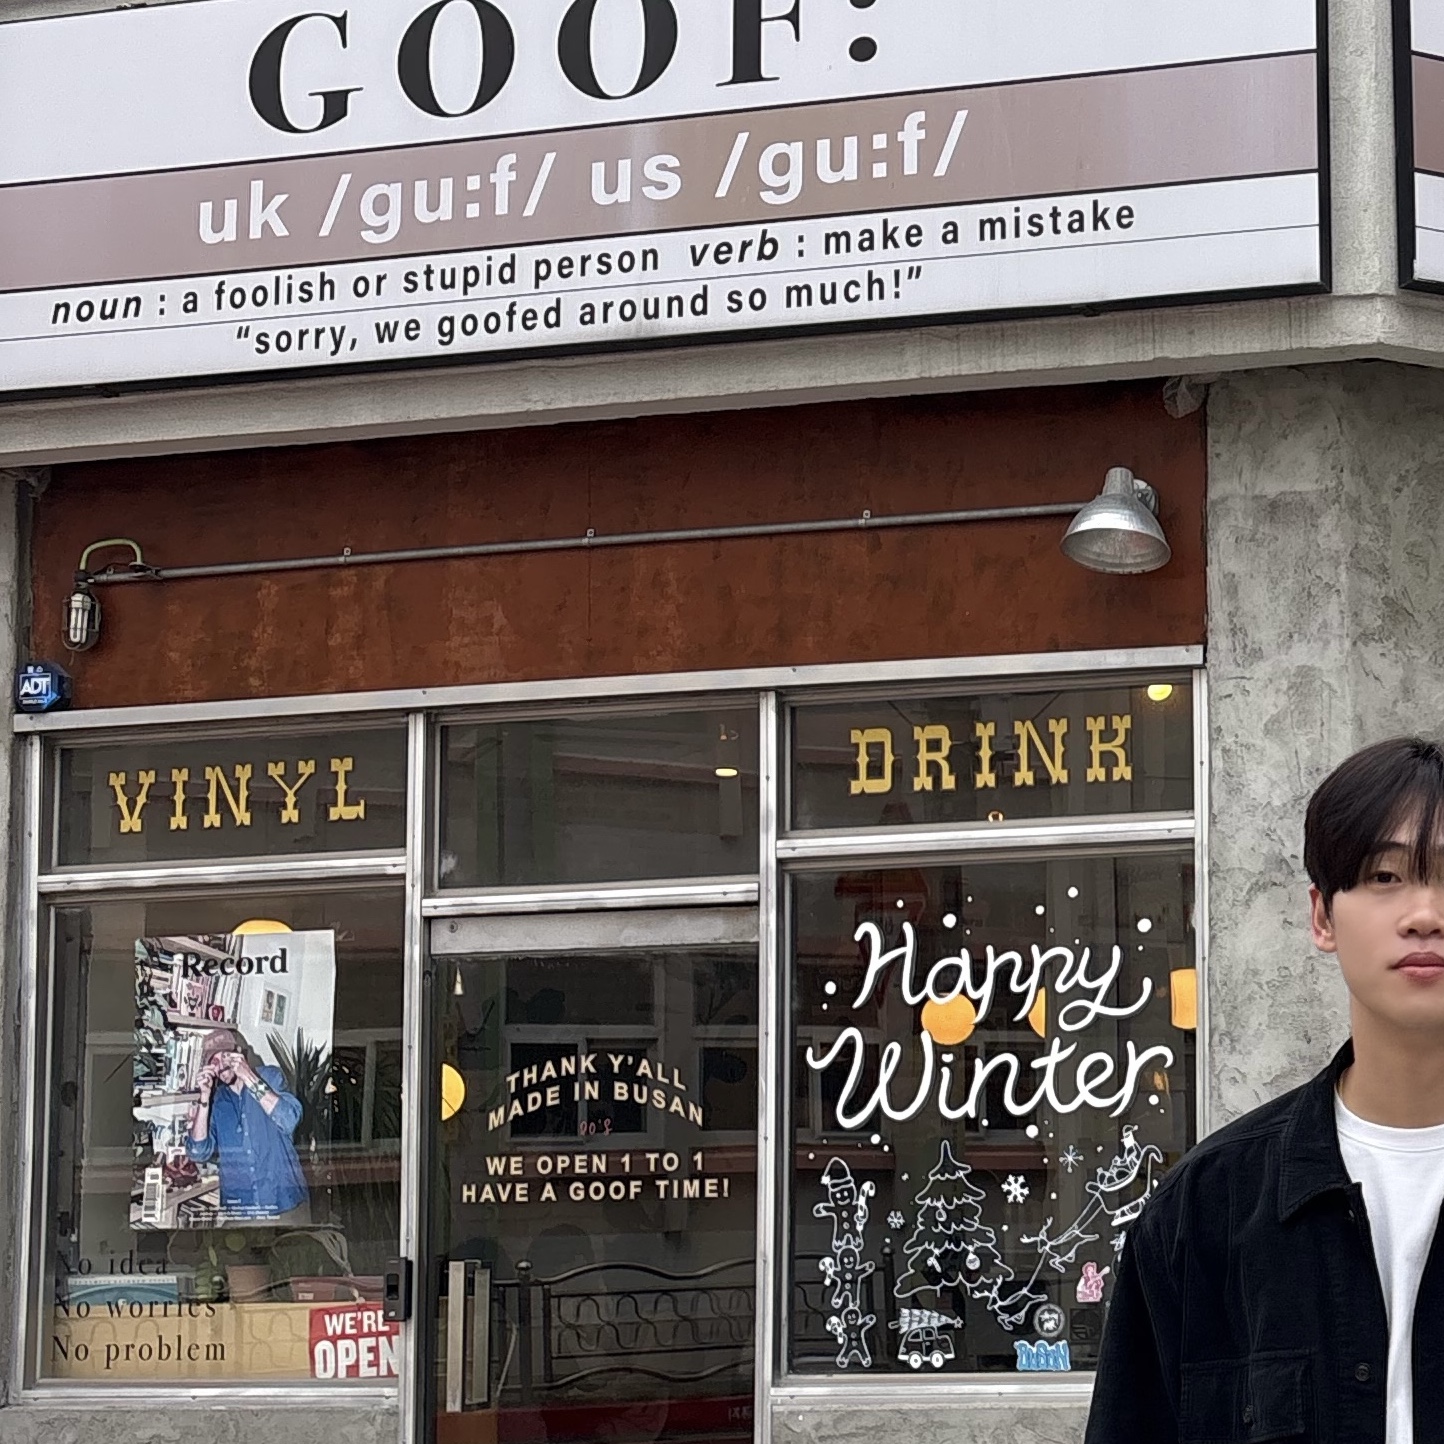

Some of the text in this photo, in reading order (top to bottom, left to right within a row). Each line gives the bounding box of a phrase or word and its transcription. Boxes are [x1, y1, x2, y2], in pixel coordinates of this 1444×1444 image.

[248, 0, 878, 134] GOOF:
[198, 109, 969, 244] uk /gu:f/ us /gu:f/
[51, 199, 1136, 325] noun : a foolish or stupid person verb : make a mistake
[236, 265, 922, 356] "sorry, we goofed around so much!"
[20, 677, 51, 696] ADT
[849, 713, 1133, 796] DRINK
[108, 755, 366, 834] VINYL
[181, 948, 289, 979] Record
[853, 921, 1153, 1032] Happy
[506, 1052, 686, 1094] THANK Y'ALL
[806, 1026, 1174, 1129] Winter
[488, 1080, 703, 1131] MADE IN BUSAN
[485, 1151, 703, 1177] WE OPEN 1 TO 1
[462, 1178, 731, 1204] HAVE A GOOF TIME!
[56, 1249, 169, 1276] No idea
[53, 1292, 217, 1319] No worries
[51, 1334, 227, 1370] No problem
[314, 1334, 400, 1379] OPEN
